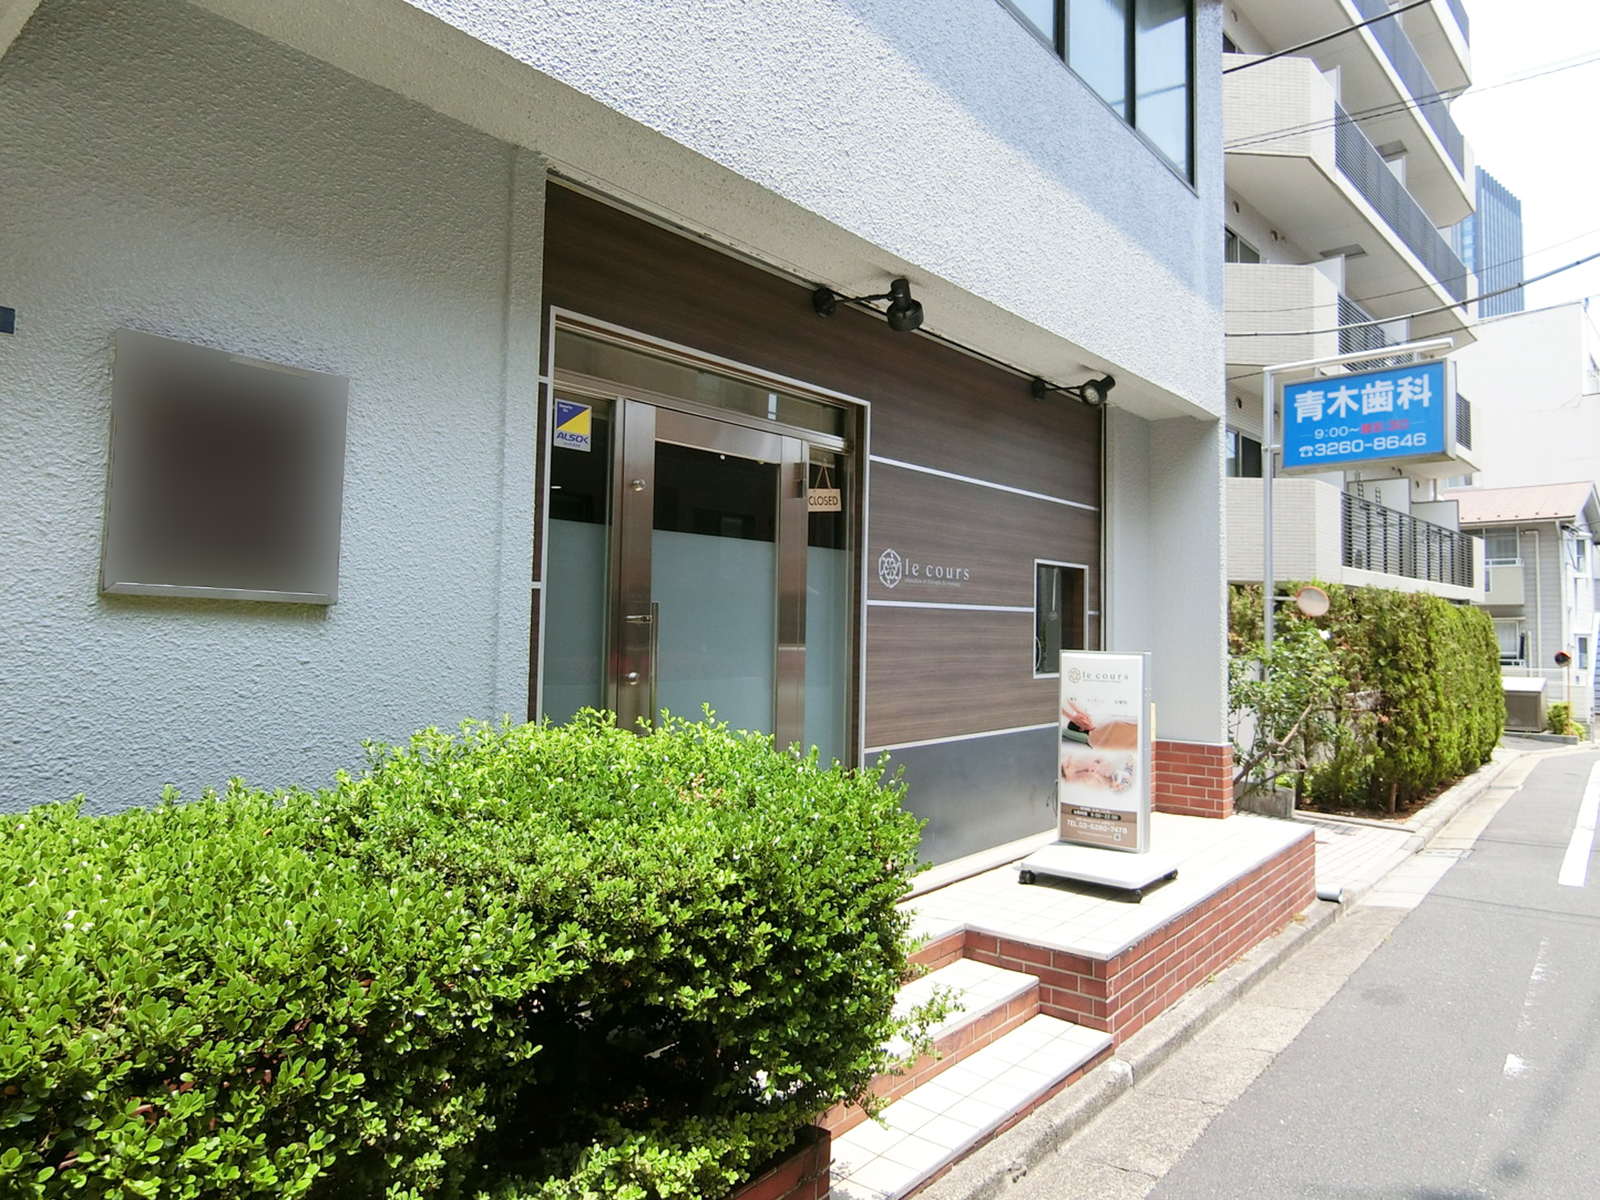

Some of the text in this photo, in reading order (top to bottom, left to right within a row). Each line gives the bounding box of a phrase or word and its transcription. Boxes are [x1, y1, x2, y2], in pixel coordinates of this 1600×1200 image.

[1294, 373, 1432, 423] 青木歯科
[556, 432, 589, 444] ALSOK
[808, 496, 839, 506] CLOSED
[905, 558, 970, 581] le cours
[1082, 671, 1092, 679] le
